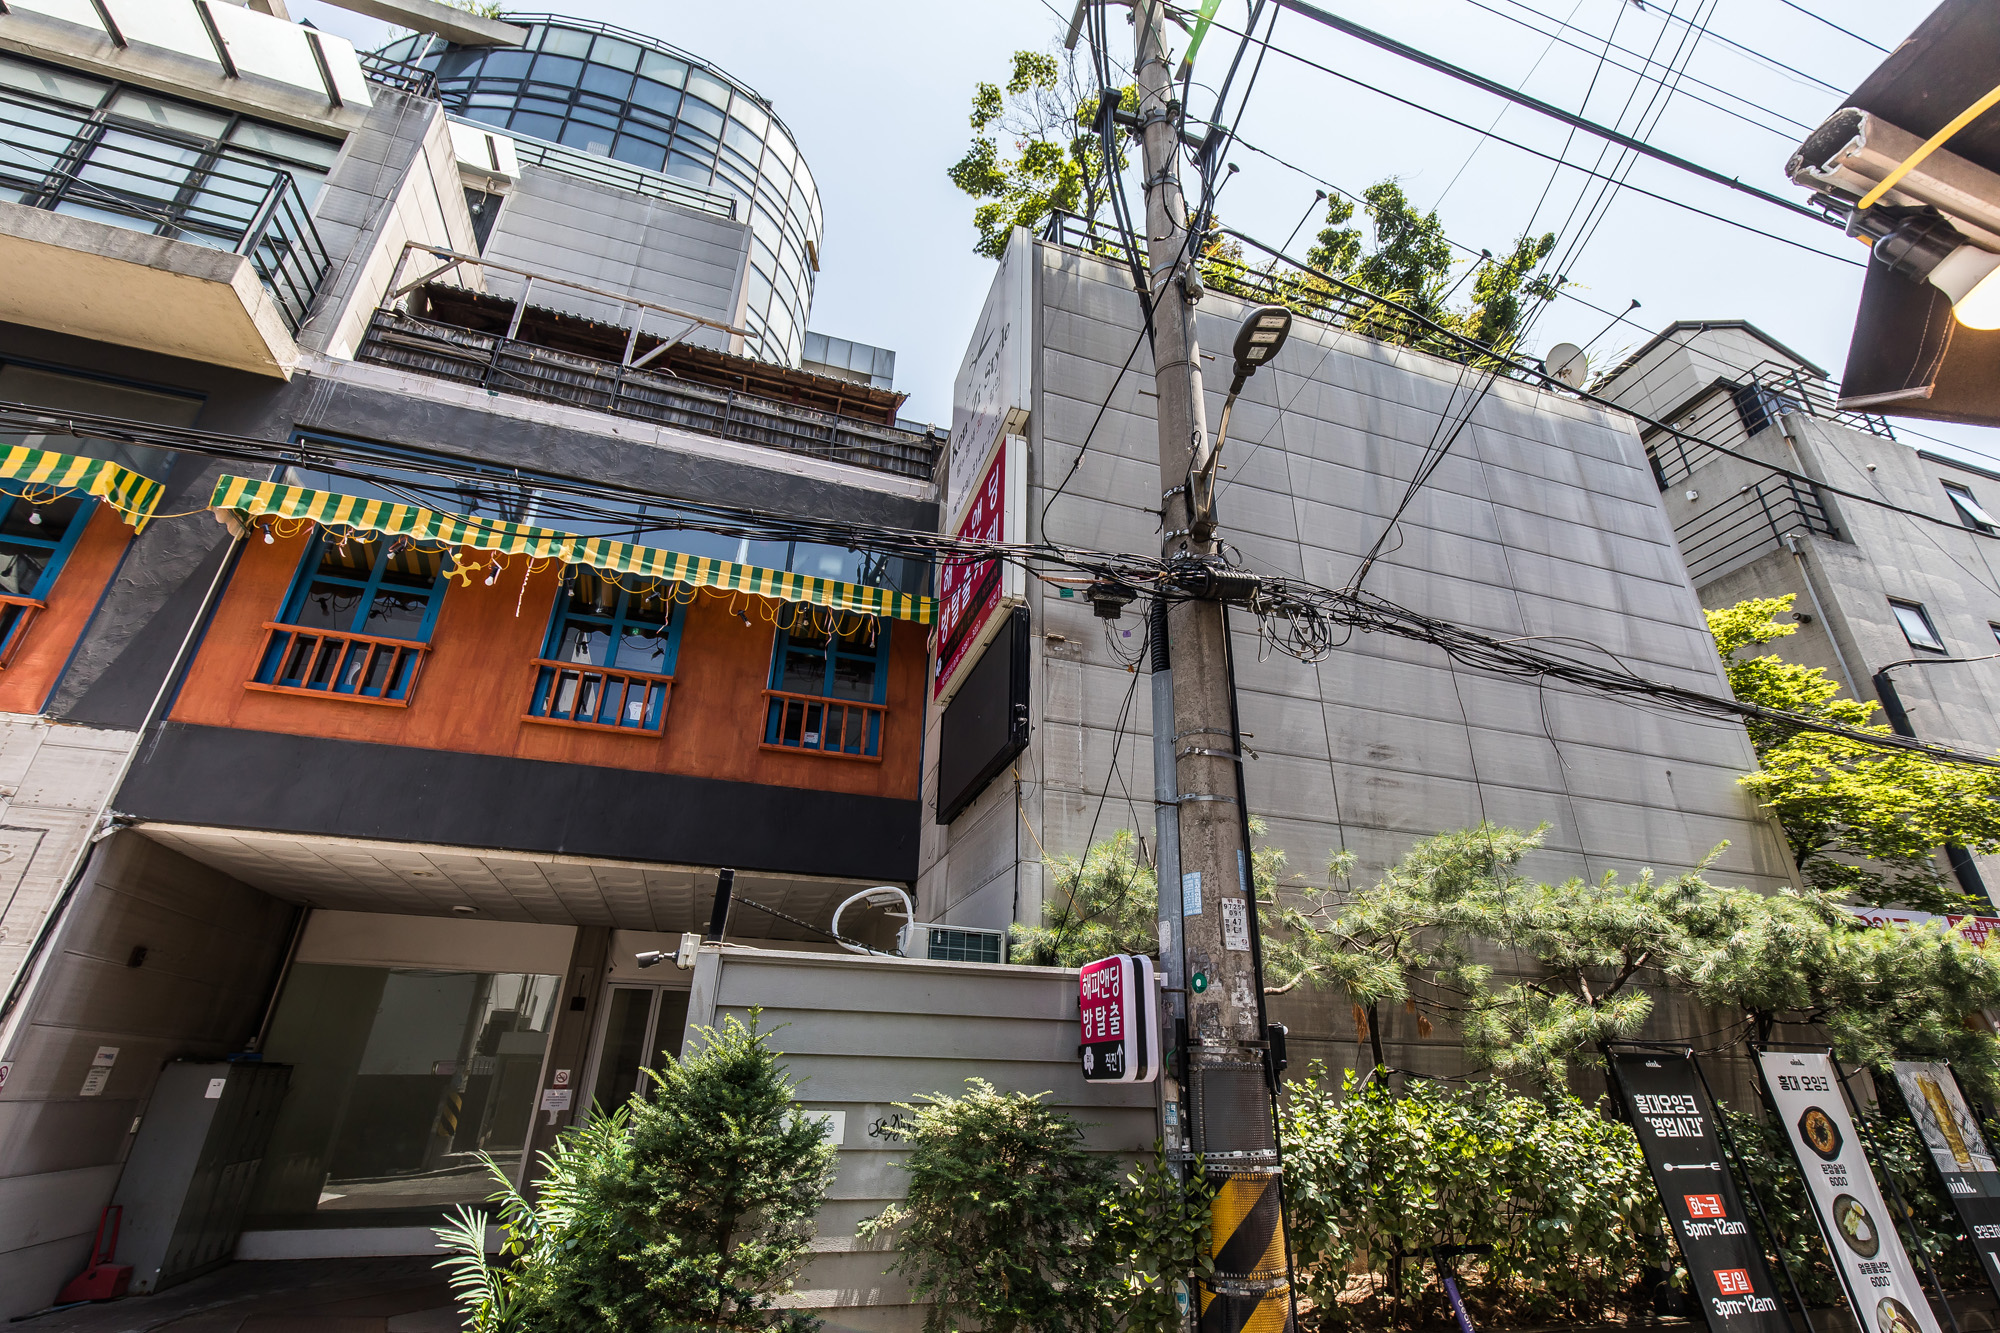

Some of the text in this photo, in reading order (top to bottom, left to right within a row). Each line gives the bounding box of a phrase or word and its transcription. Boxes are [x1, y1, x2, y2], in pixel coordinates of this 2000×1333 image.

[951, 422, 968, 467] Ken
[985, 322, 1010, 390] Style
[1232, 918, 1242, 926] 47
[1082, 965, 1120, 1000] 해피앤딩
[1105, 1052, 1118, 1072] 직진
[1777, 1075, 1830, 1092] 홍대 오잉크
[1633, 1094, 1700, 1114] 홍대오잉크
[1828, 1176, 1848, 1187] 6000
[1688, 1196, 1721, 1215] 화~금
[1682, 1218, 1747, 1240] 5pm~12am
[1718, 1271, 1750, 1292] 토/일
[1869, 1276, 1891, 1288] 6000
[1711, 1294, 1777, 1320] 3pm~12am
